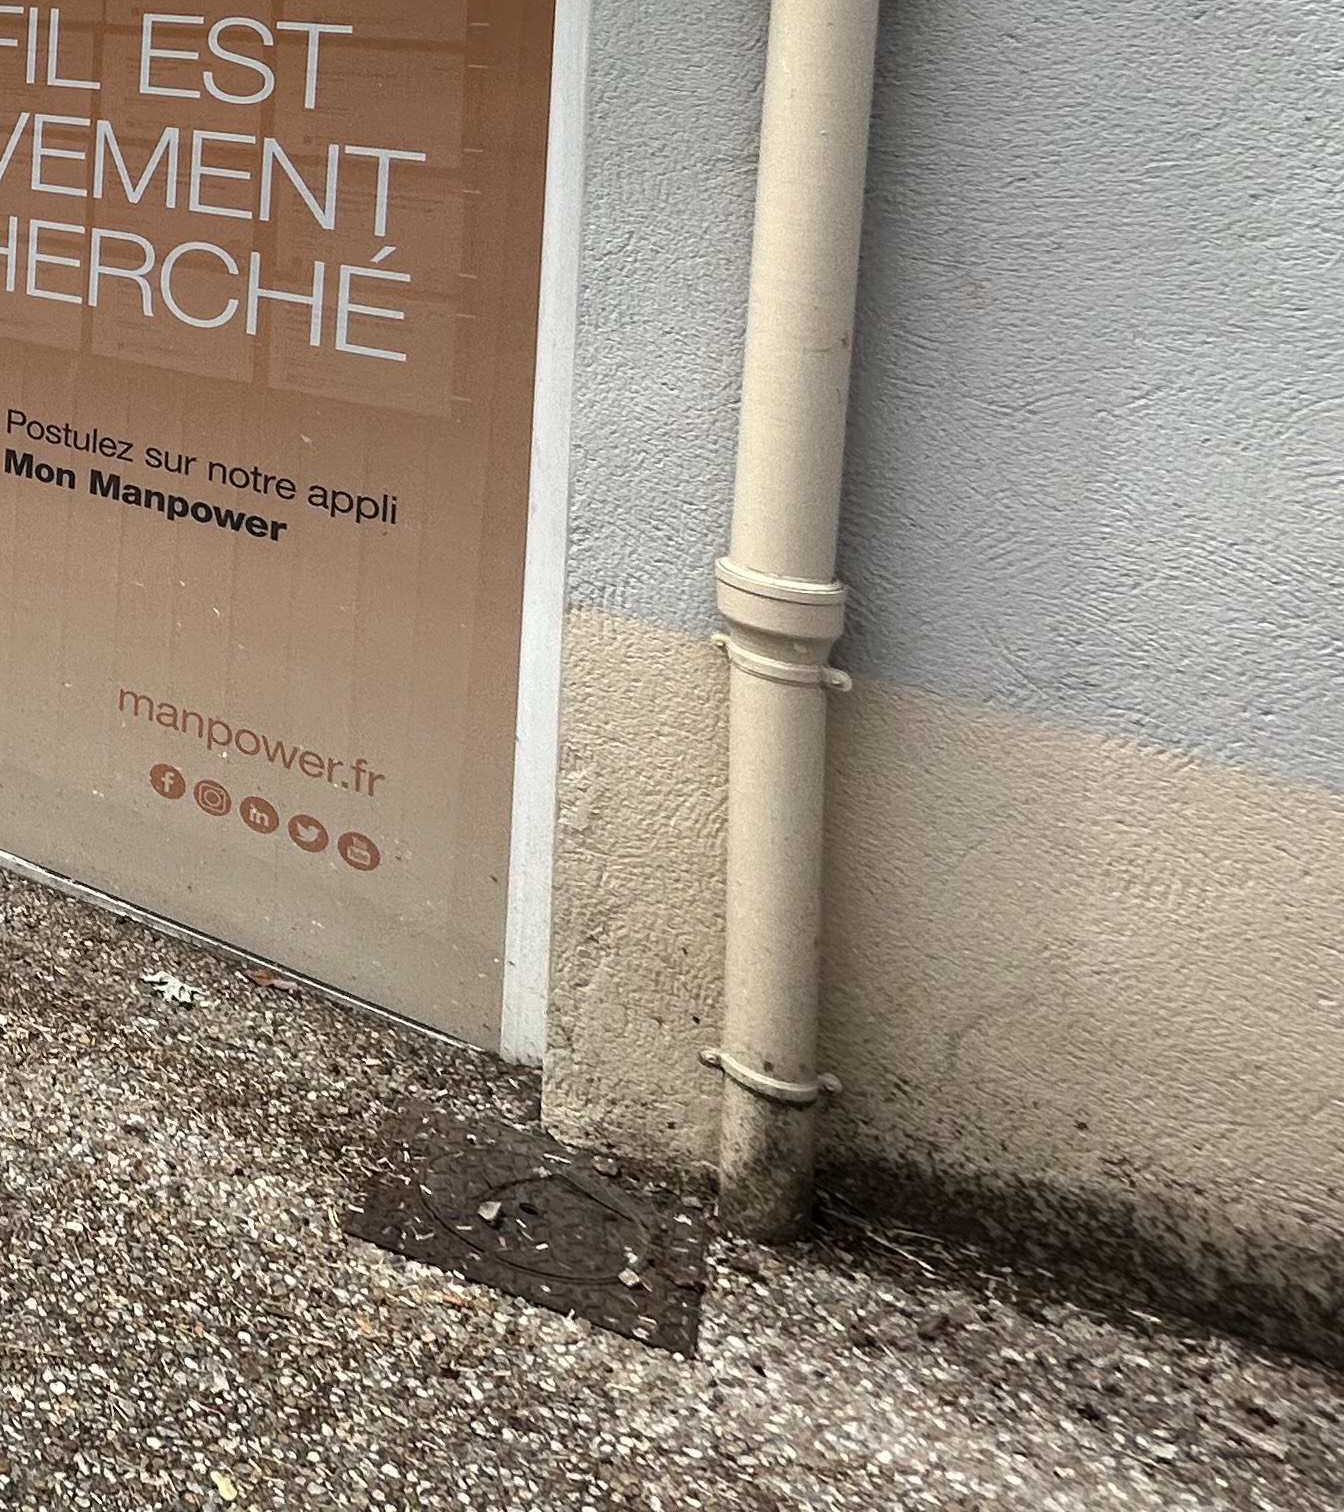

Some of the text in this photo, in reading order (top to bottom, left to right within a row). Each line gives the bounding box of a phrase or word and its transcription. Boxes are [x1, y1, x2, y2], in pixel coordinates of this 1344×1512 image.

[138, 11, 354, 109] EST
[4, 448, 288, 542] Mon Manpower
[6, 408, 399, 525] Postulez sur notre appli
[118, 688, 386, 798] manpower.fr
